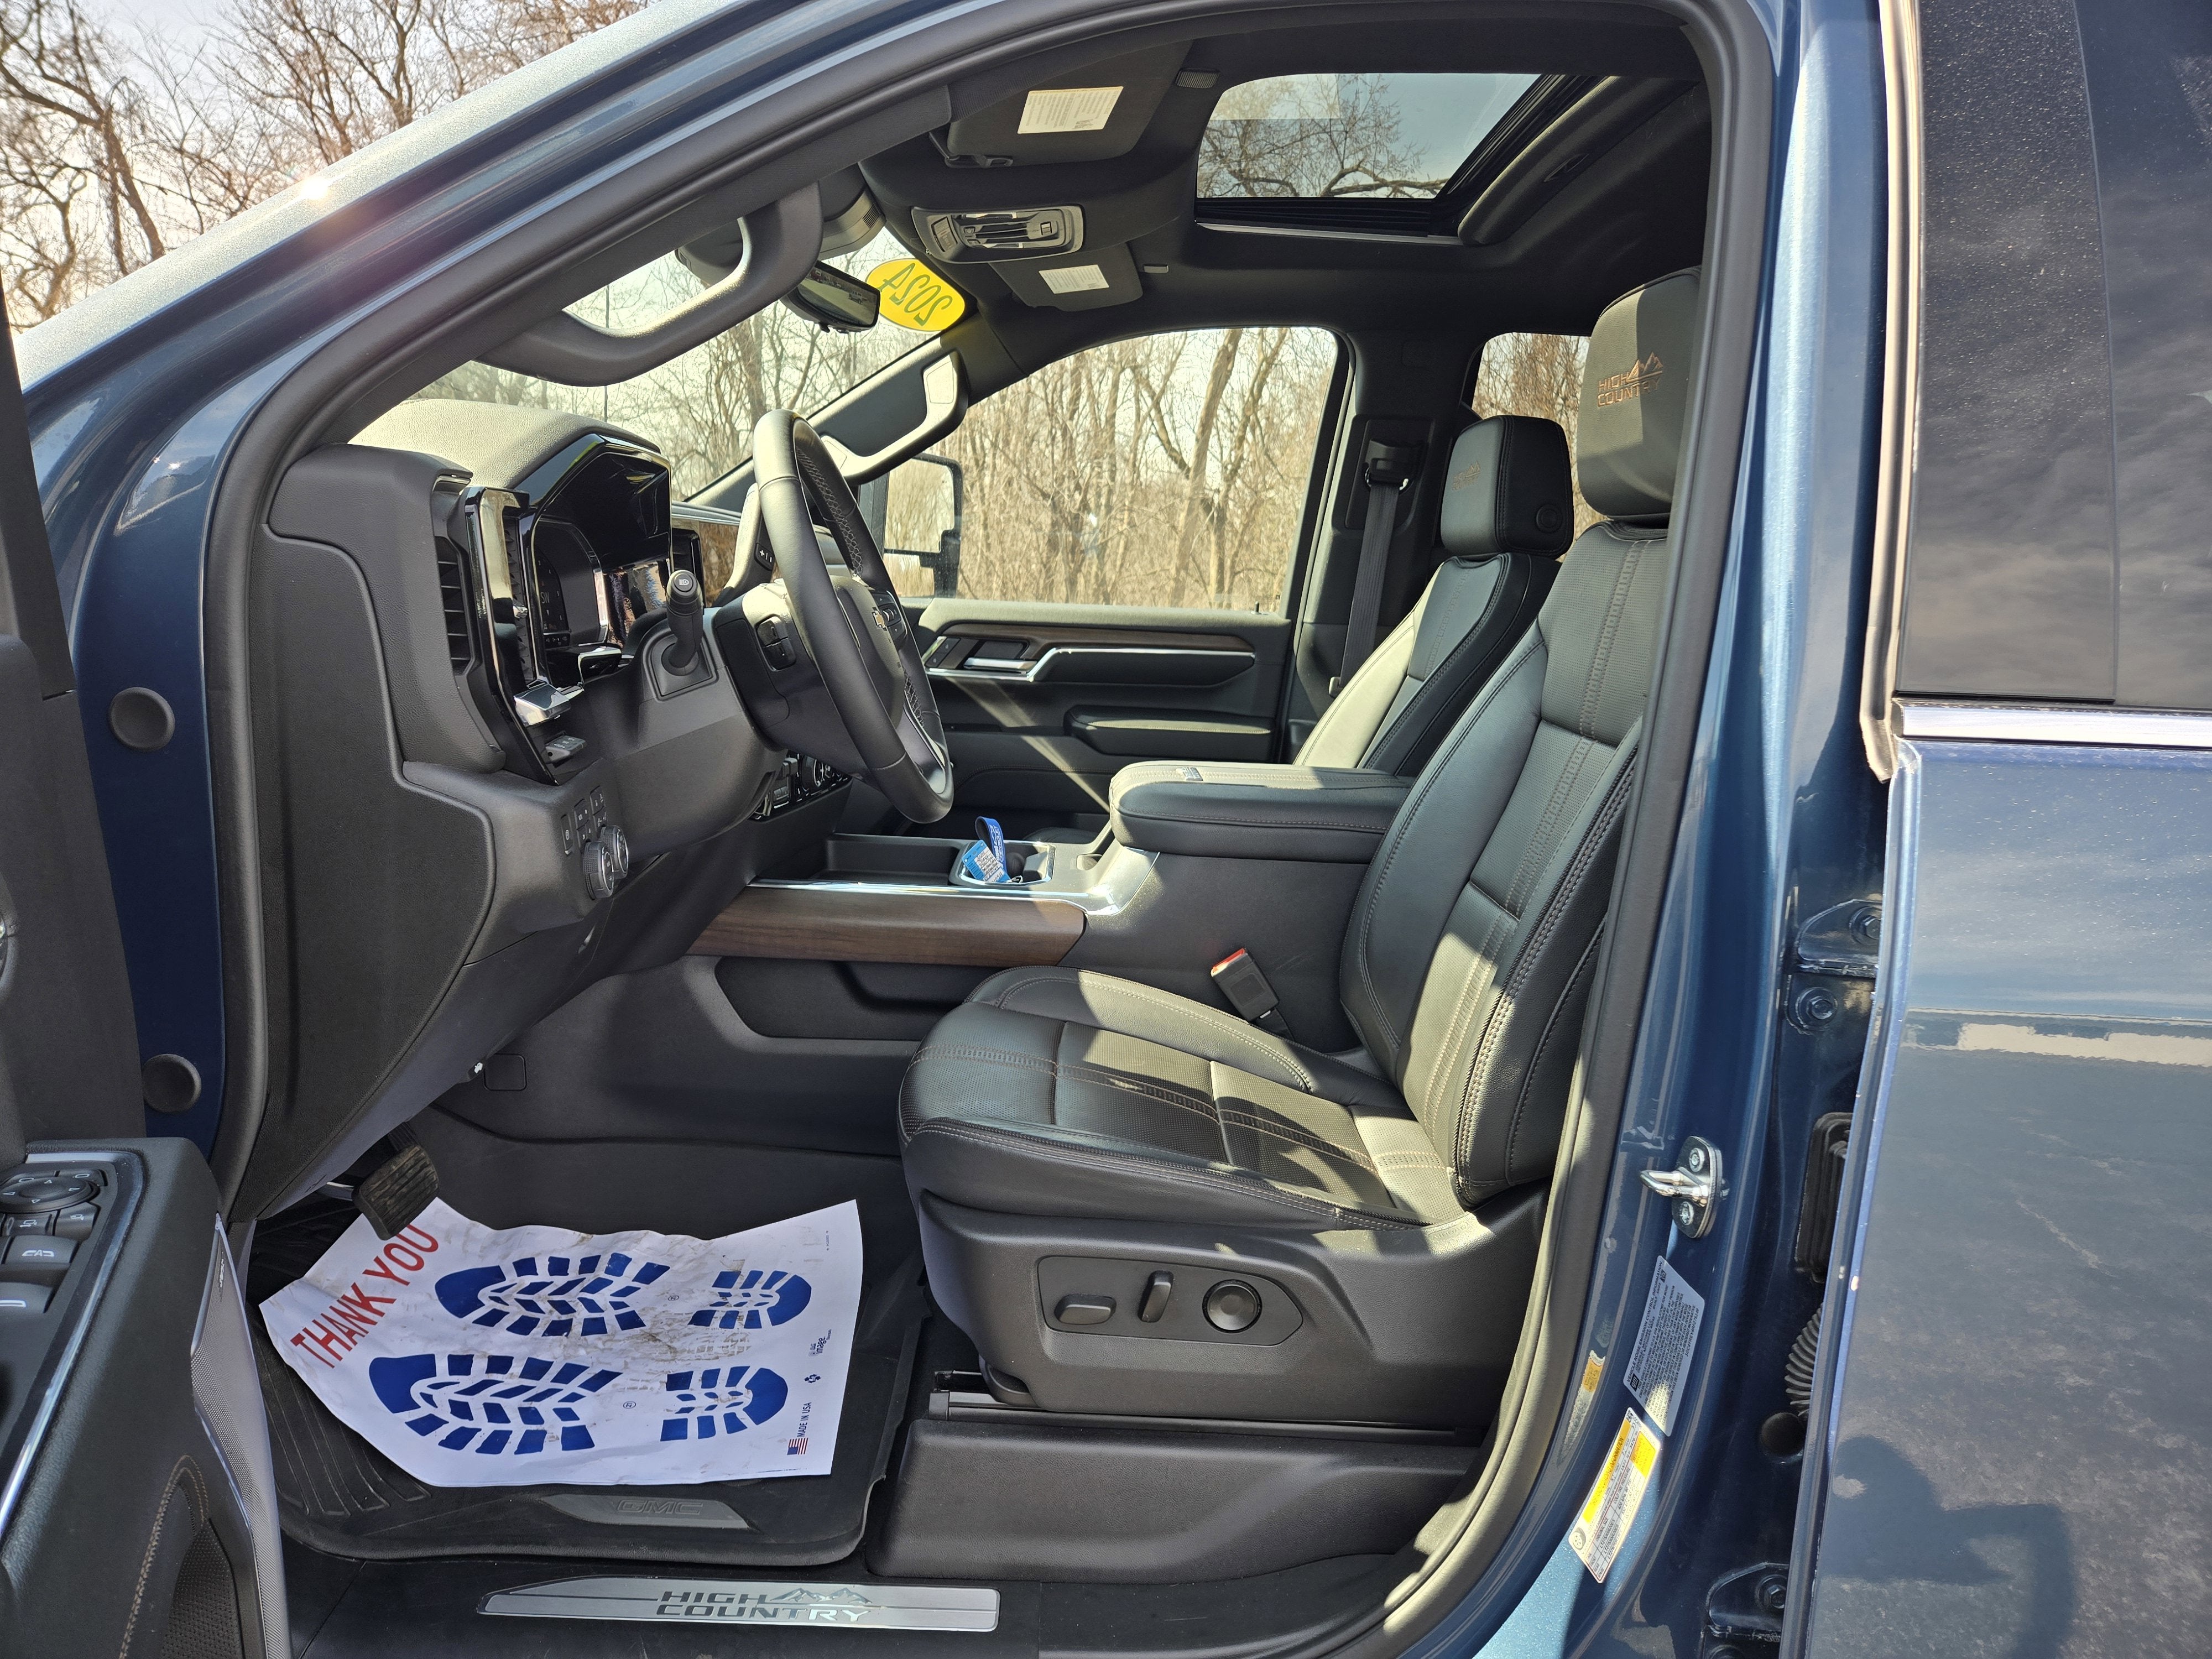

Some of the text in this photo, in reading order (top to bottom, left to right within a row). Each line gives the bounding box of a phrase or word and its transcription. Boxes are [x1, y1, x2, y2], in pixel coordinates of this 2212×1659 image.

[1598, 372, 1629, 393] HIGH
[1598, 378, 1659, 406] COUNTRY
[362, 1224, 439, 1286] YOU
[290, 1282, 397, 1369] THANK
[1627, 1360, 1636, 1383] VEHICLE
[1639, 1320, 1647, 1345] EMISSION
[1645, 1296, 1653, 1321] CONTROL
[1652, 1261, 1662, 1296] INFORMATION
[1631, 1375, 1637, 1389] gm
[802, 1401, 812, 1413] USA
[797, 1422, 808, 1437] MADE
[1609, 1435, 1623, 1468] INFORMATION
[617, 1499, 704, 1515] GMC
[660, 1591, 769, 1604] HIGH
[656, 1604, 871, 1622] COUNTRY
